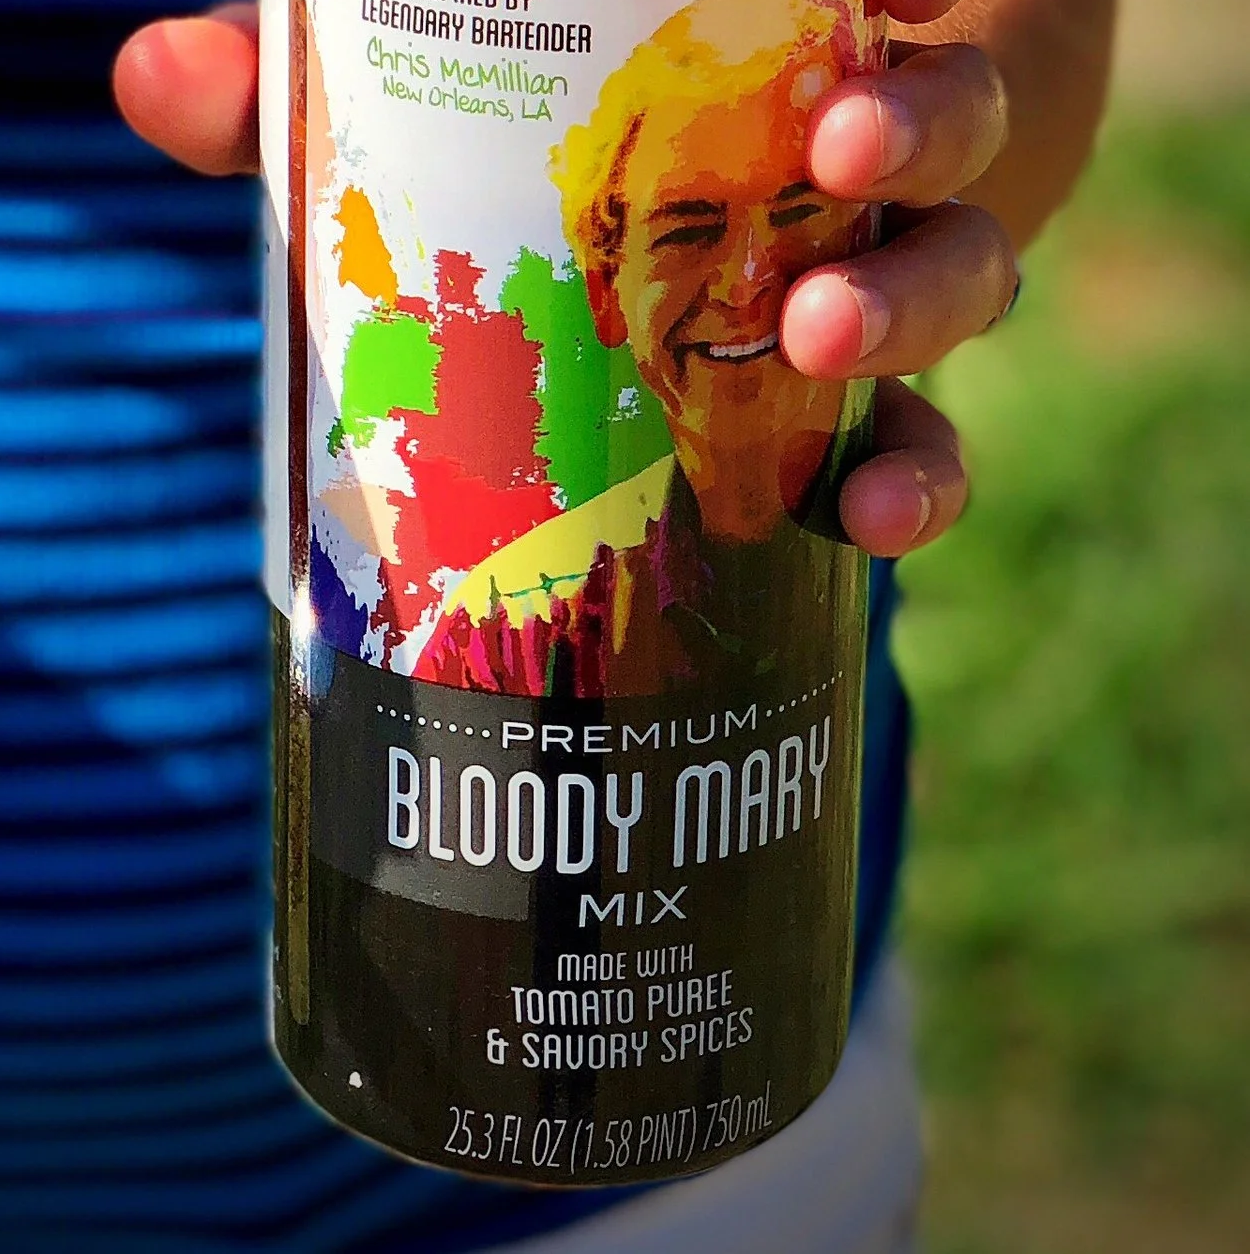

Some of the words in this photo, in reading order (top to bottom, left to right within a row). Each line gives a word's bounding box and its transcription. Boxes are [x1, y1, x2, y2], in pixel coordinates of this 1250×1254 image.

[471, 16, 592, 53] BARTENDER
[366, 36, 431, 79] Chris
[439, 56, 568, 96] McMillian
[382, 75, 423, 104] New
[428, 86, 514, 123] Orleans,
[521, 98, 553, 122] LA
[502, 703, 757, 753] PREMIUM
[387, 746, 644, 876] BLOODY
[672, 715, 831, 868] MARY
[578, 885, 689, 928] MIX
[557, 952, 627, 982] MADE
[636, 943, 694, 978] WITH
[510, 986, 634, 1026] TOMATO
[647, 969, 733, 1022] PUREE
[486, 1028, 510, 1065] &
[521, 1030, 648, 1070] SAVORY
[660, 1006, 754, 1063] SPICES
[444, 1106, 495, 1160] 25.3
[498, 1114, 523, 1165] FL
[531, 1118, 567, 1168] OZ
[570, 1118, 633, 1175] (1.58
[635, 1105, 697, 1165] PINT)
[702, 1094, 742, 1151] 750
[744, 1080, 773, 1136] mL
